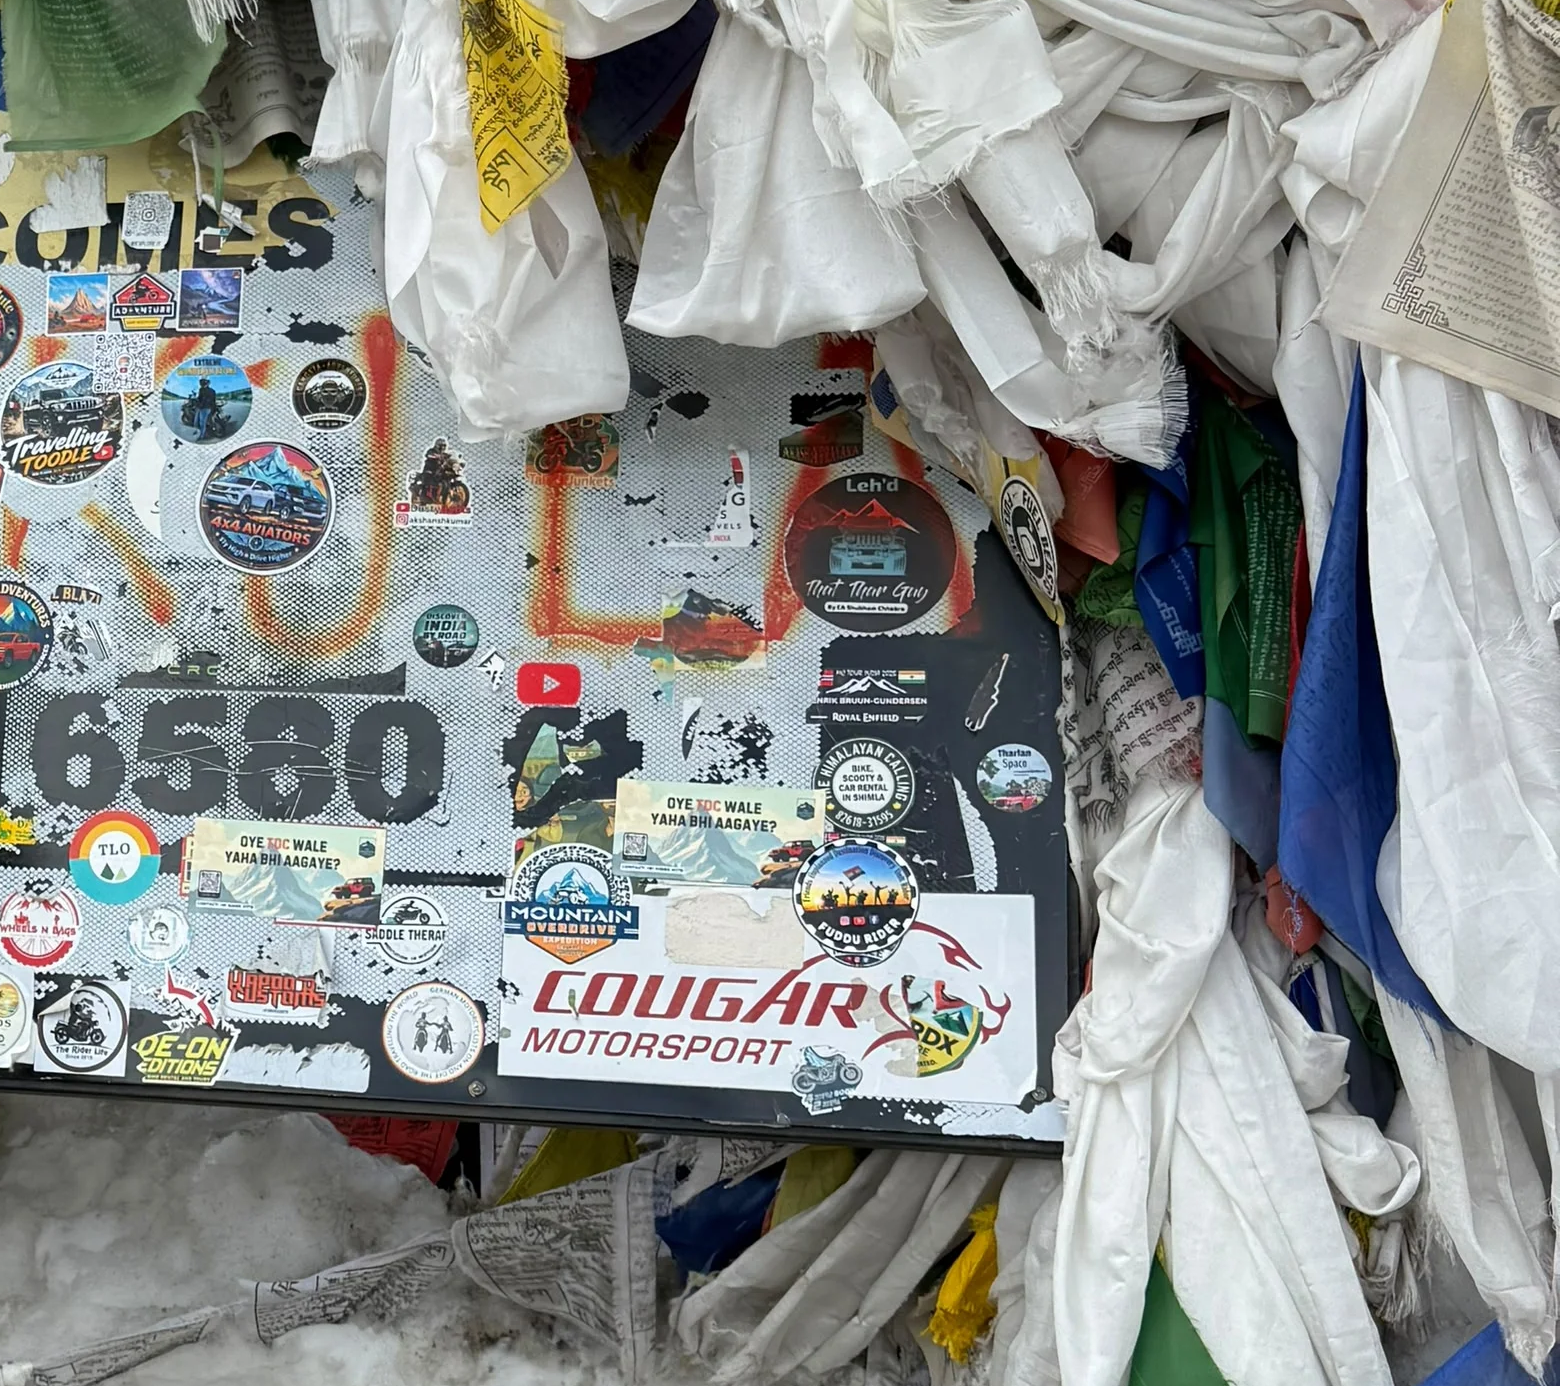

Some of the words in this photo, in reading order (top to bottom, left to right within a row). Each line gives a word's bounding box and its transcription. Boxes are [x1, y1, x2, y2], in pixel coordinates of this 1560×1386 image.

[5, 427, 113, 468] Travelling
[20, 446, 94, 477] TOODLE
[845, 477, 900, 493] Leh'd
[242, 524, 312, 546] AVIATORS
[806, 578, 845, 599] That
[849, 580, 888, 601] Thar
[892, 581, 929, 604] Guy
[424, 620, 467, 632] INDIA
[423, 632, 436, 640] BY
[439, 631, 467, 640] ROAD
[839, 696, 928, 706] BRUUN-GUNDERSEN
[832, 713, 861, 722] ROYAL
[862, 712, 900, 722] ENFIELD
[820, 742, 884, 779] HIMALAYAN
[883, 747, 908, 803] CALLING
[842, 774, 875, 783] SCOOTY
[838, 783, 856, 792] CAR
[857, 783, 889, 792] RENTAL
[666, 796, 694, 811] OYE
[723, 800, 763, 815] WALE
[841, 793, 850, 801] IN
[851, 793, 885, 802] SHIMLA
[651, 813, 687, 827] YAHA
[689, 815, 713, 829] BHI
[714, 817, 778, 833] AAGAYE?
[98, 842, 132, 856] TLO
[239, 835, 265, 849] OYE
[292, 839, 328, 853] WALE
[225, 850, 258, 864] YAHA
[259, 852, 282, 865] BHI
[282, 855, 341, 870] AAGAYE?
[511, 905, 632, 924] MOUNTAIN
[0, 922, 38, 934] WHEELS
[41, 925, 49, 934] N
[52, 925, 77, 937] BAGS
[365, 929, 405, 940] SADDLE
[526, 921, 617, 936] OVERDRIVE
[817, 921, 861, 945] FUDDU
[863, 918, 902, 944] RIDER
[542, 936, 598, 946] EXPEDITION
[532, 969, 869, 1029] COUGAR
[55, 1045, 70, 1054] The
[71, 1045, 92, 1055] Rider
[93, 1048, 109, 1057] Life
[520, 1027, 793, 1067] MOTORSPORT
